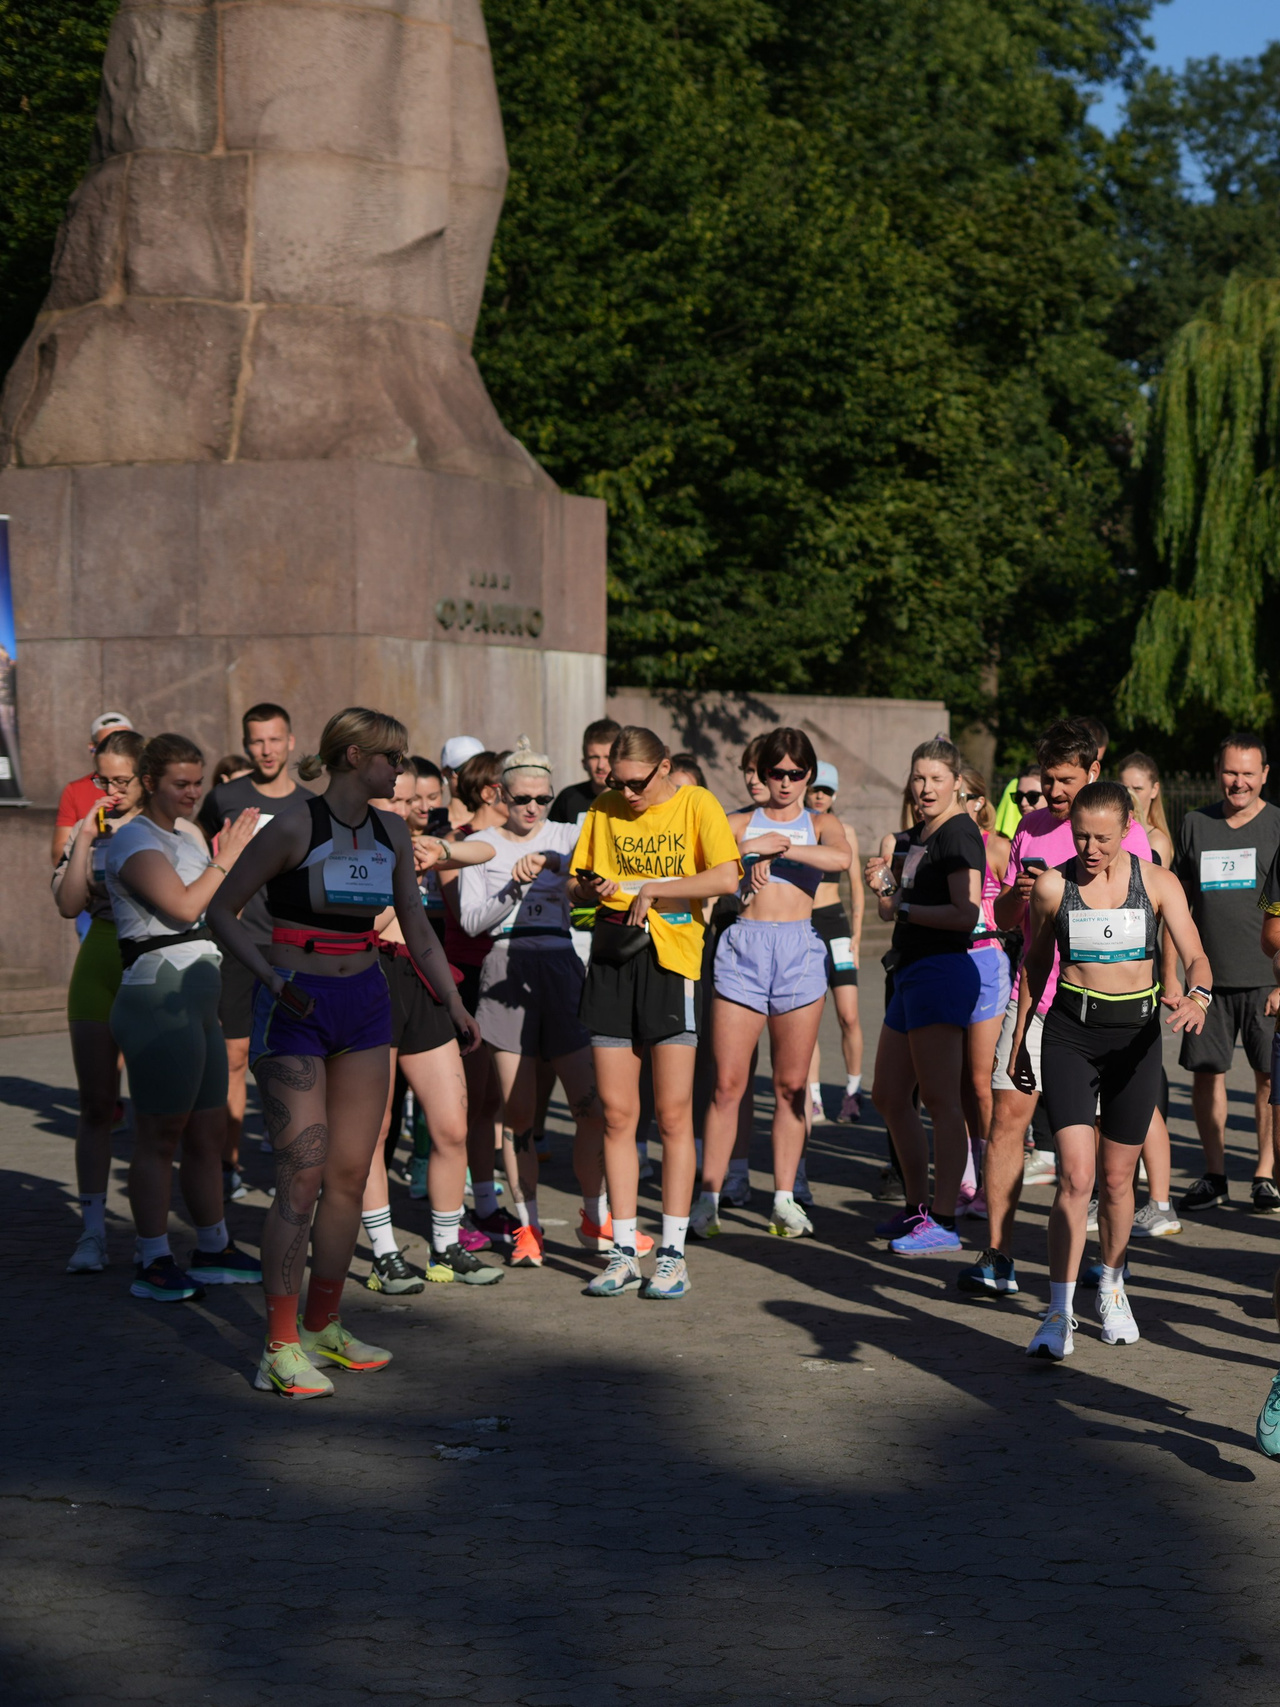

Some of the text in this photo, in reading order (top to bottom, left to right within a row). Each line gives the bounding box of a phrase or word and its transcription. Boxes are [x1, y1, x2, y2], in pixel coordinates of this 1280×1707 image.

[614, 831, 686, 856] КВАДРІК
[349, 864, 368, 879] 20
[1221, 861, 1235, 872] 73
[527, 904, 543, 917] 19
[1104, 925, 1113, 938] 6
